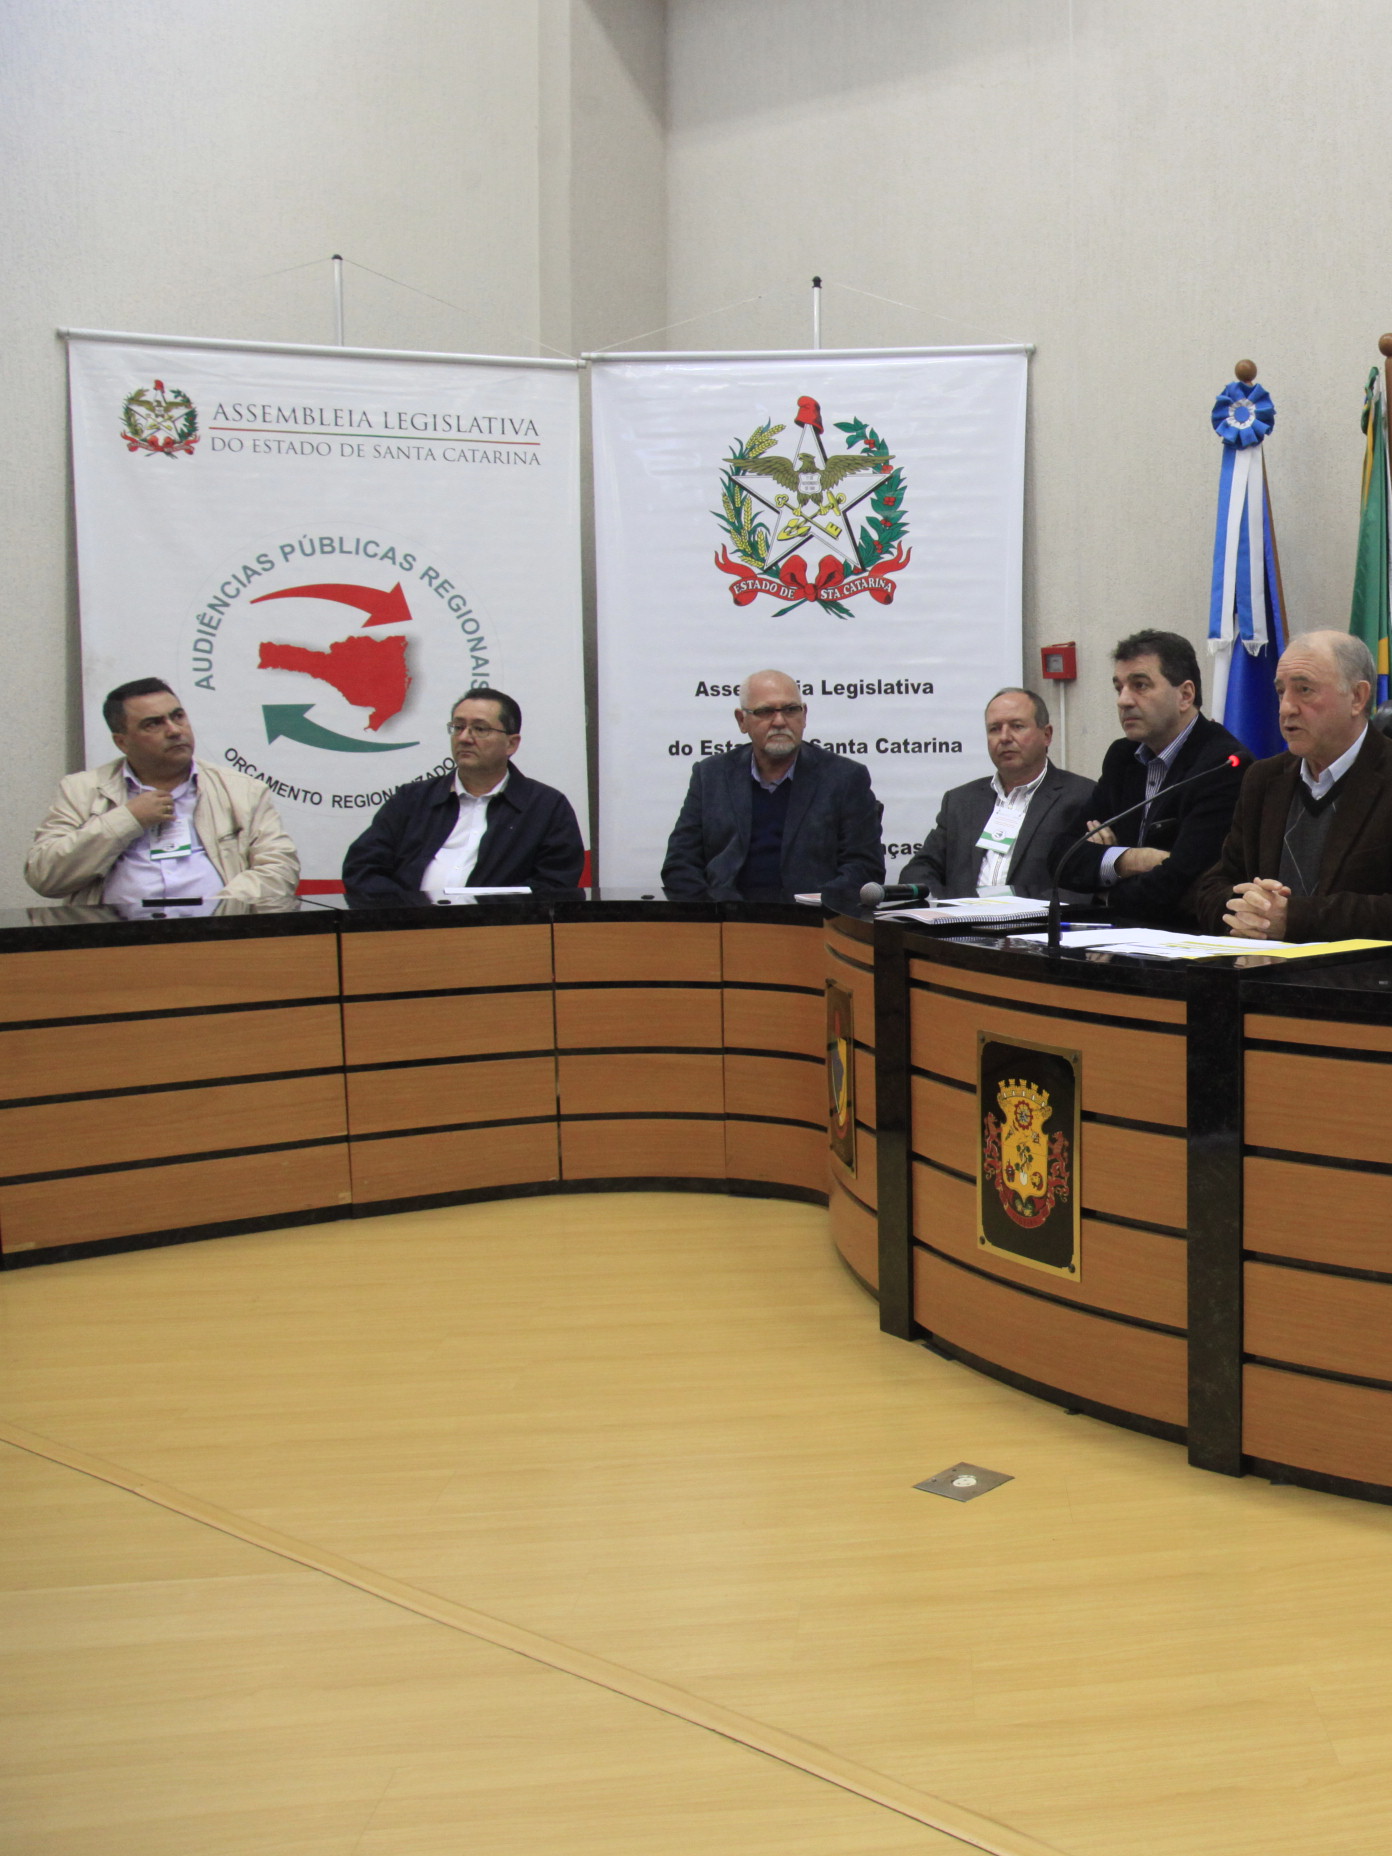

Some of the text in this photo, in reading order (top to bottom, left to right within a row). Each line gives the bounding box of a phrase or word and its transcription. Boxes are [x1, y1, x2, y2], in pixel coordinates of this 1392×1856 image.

[213, 402, 540, 437] ASSEMBLEIA LEGISLATIVA
[211, 436, 244, 452] DO
[252, 438, 331, 456] ESTADO
[340, 442, 366, 458] DE
[373, 444, 436, 461] SANTA
[443, 448, 541, 466] CATARINA
[734, 579, 777, 595] ESTADO
[780, 586, 795, 599] DE
[844, 578, 892, 595] CATARINA
[192, 534, 490, 691] AUDIÊNCIAS PÚBLICAS REGIONAIS
[822, 680, 934, 699] Legislativa
[668, 740, 693, 756] do
[700, 740, 744, 756] Est
[876, 738, 962, 754] Catarina
[332, 757, 455, 809] REGIONADO
